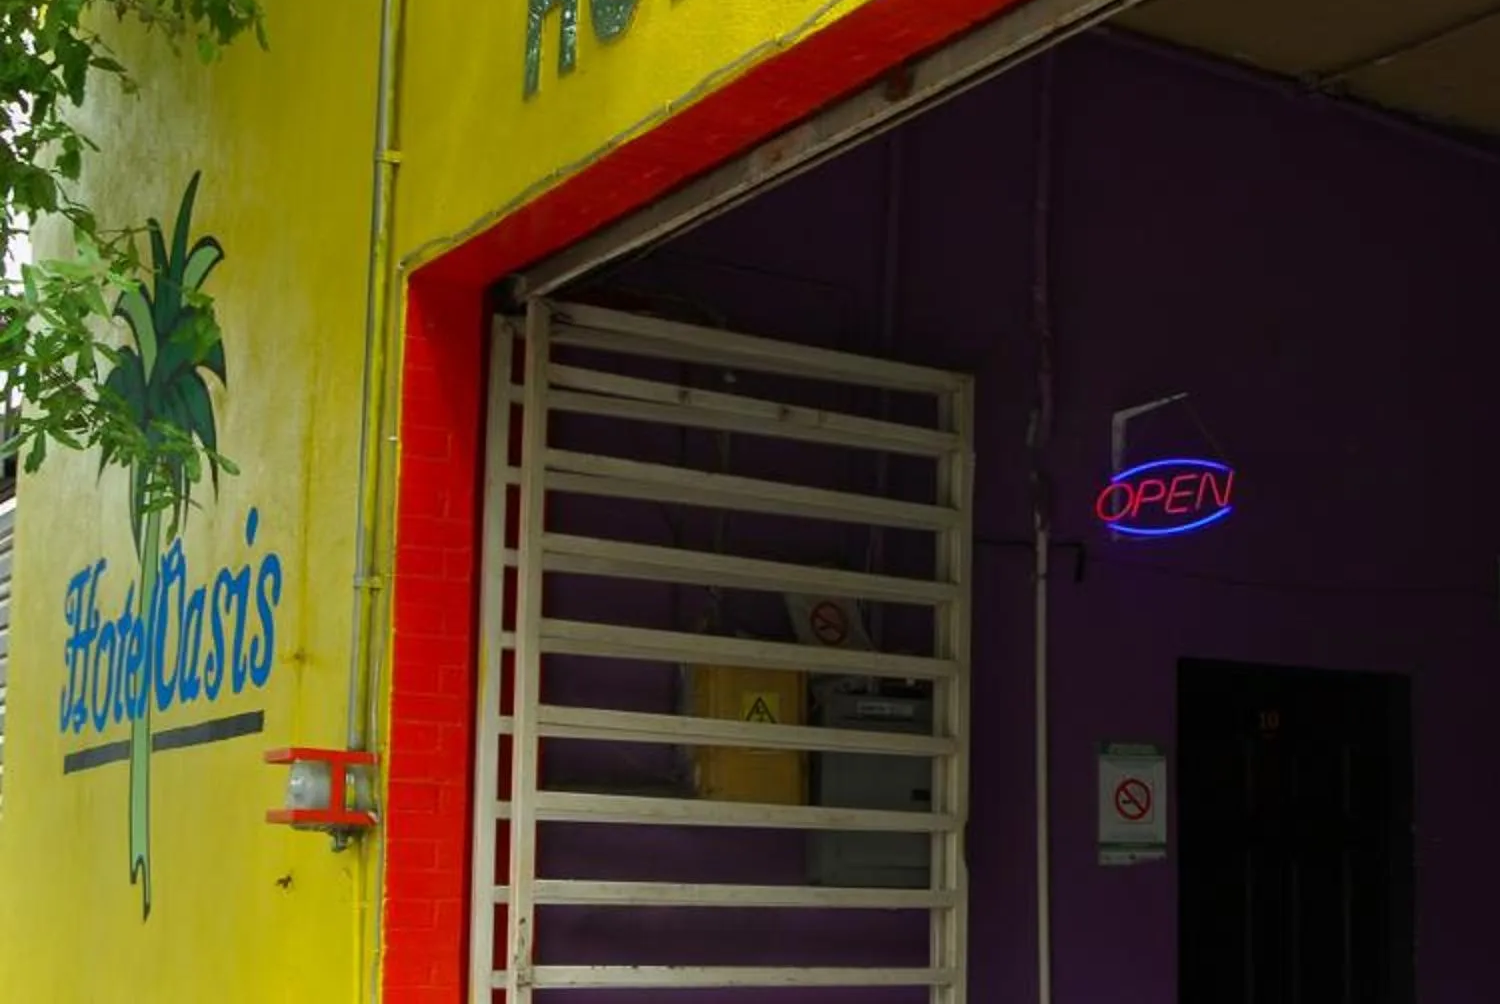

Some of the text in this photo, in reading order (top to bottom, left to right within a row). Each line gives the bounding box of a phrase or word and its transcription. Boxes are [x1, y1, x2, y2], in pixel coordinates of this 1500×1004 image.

[1096, 468, 1235, 521] OPEN
[60, 506, 282, 734] Hotel Oasis
